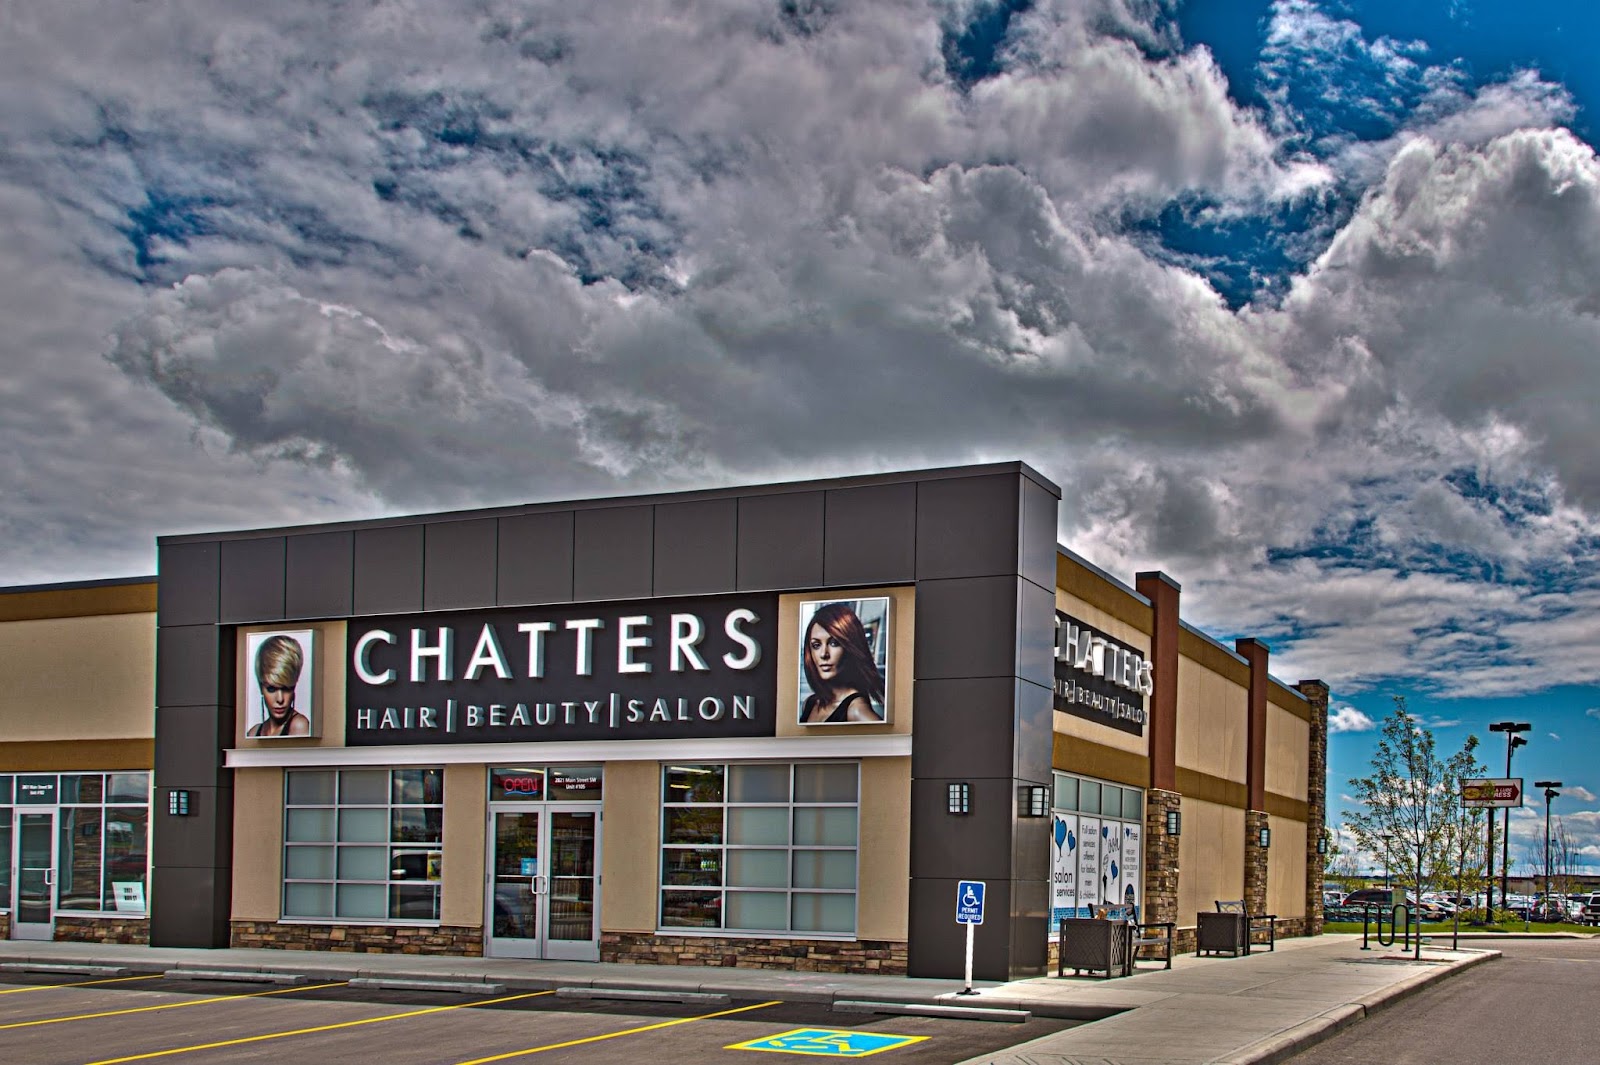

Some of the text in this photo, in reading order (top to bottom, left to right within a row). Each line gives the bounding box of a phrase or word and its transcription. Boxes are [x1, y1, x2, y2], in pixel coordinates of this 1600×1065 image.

[353, 608, 762, 686] CHATTERS
[1076, 687, 1116, 715] BEAUTY
[357, 695, 756, 730] HAIR BEAUTY SALON
[504, 777, 538, 792] OPEN
[1088, 826, 1097, 836] salon
[1054, 866, 1073, 884] salon
[1056, 888, 1075, 898] services
